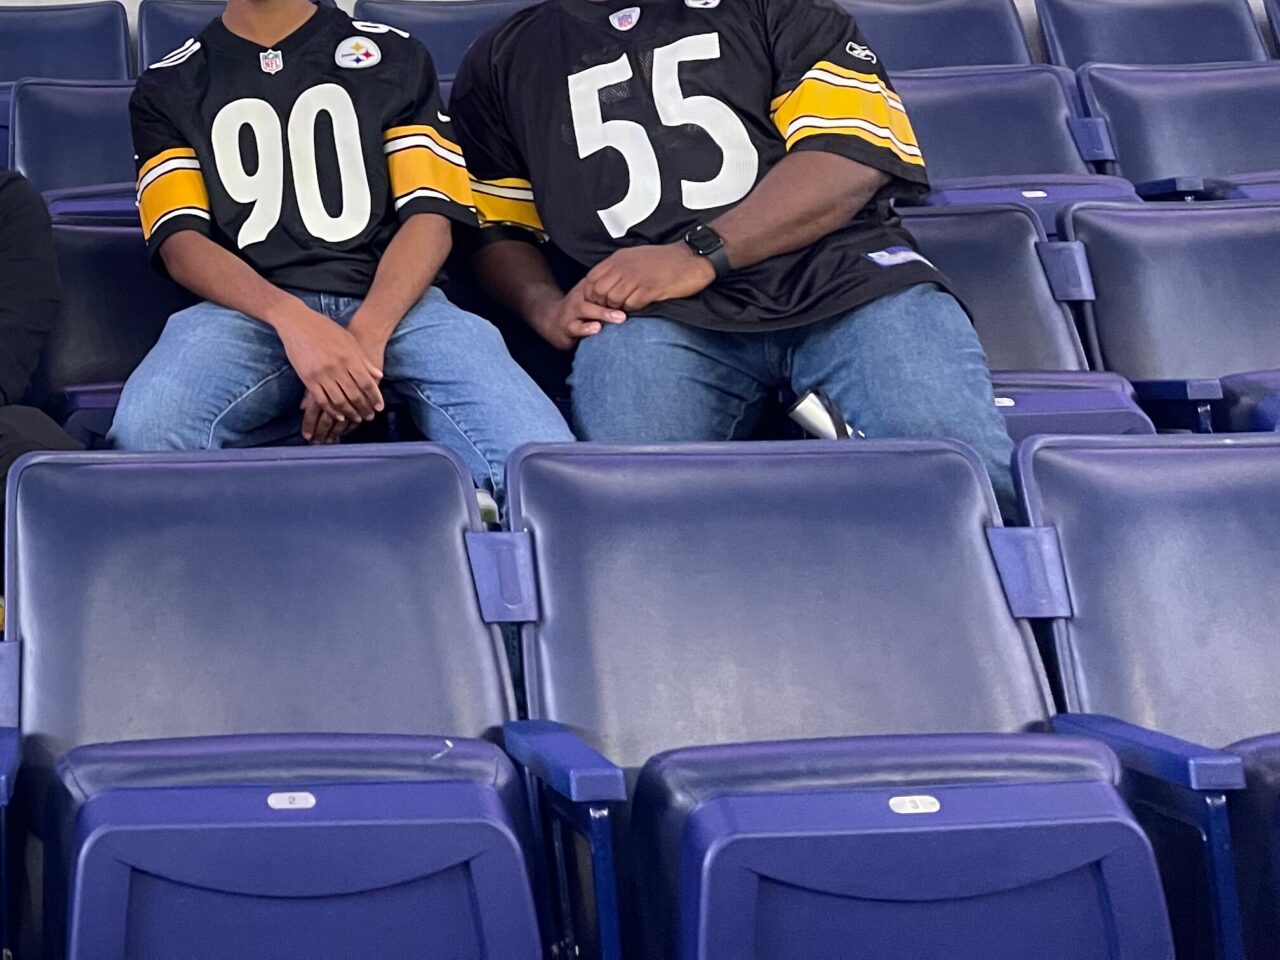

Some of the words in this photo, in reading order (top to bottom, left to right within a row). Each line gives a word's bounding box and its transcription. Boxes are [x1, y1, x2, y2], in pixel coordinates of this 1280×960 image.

[264, 59, 279, 69] NFL
[211, 83, 372, 250] 90
[568, 32, 759, 239] 55
[288, 795, 296, 805] 2
